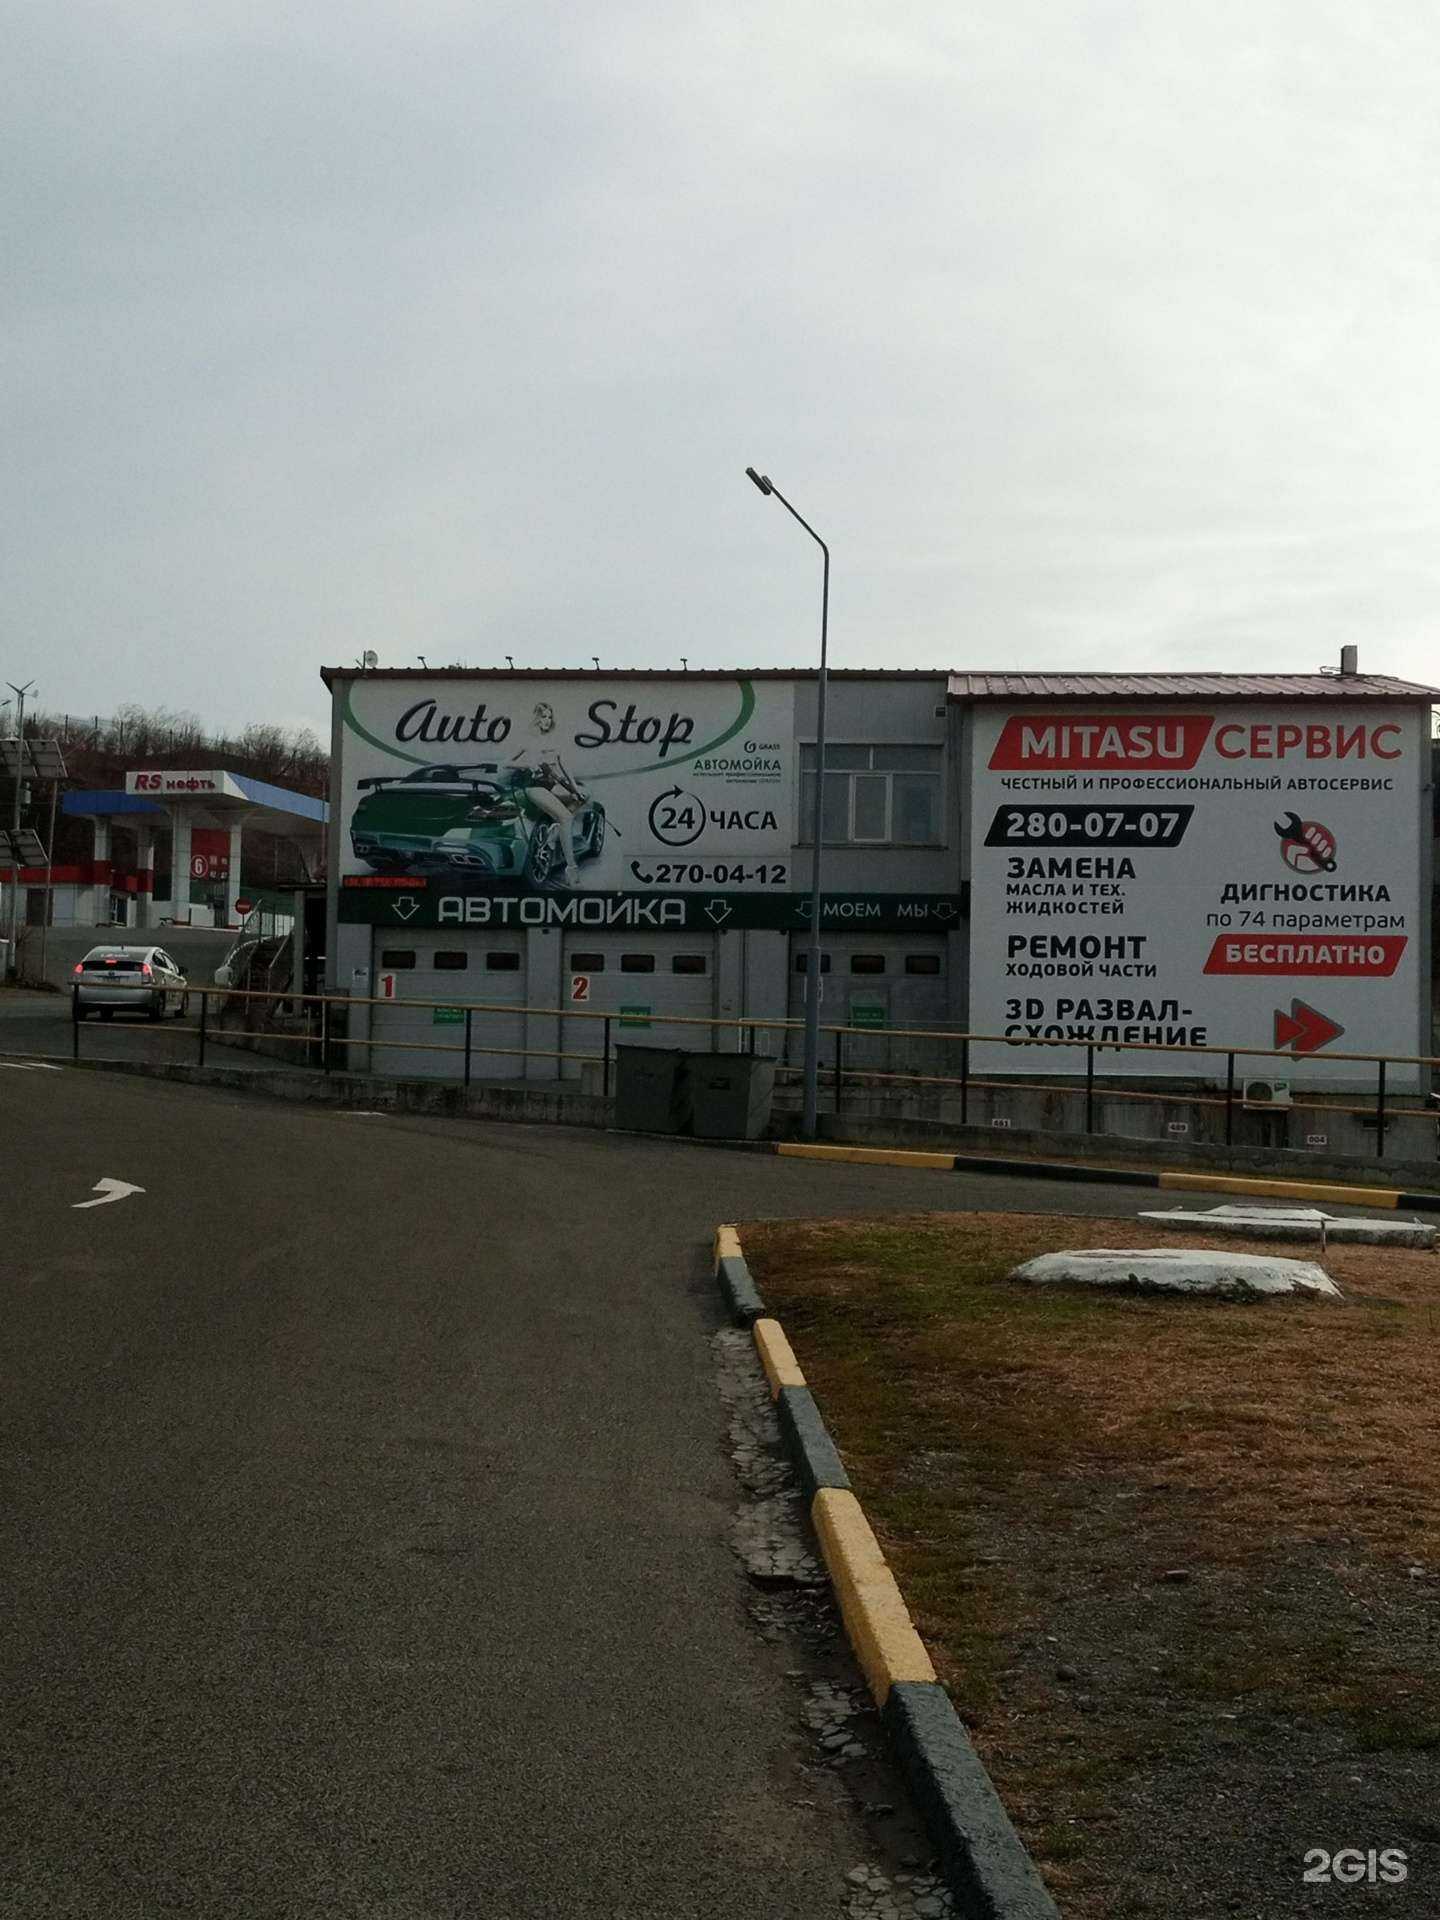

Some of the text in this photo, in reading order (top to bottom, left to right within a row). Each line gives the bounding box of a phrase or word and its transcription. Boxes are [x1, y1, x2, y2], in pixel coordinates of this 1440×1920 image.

[395, 698, 695, 757] Auto Stop
[1021, 724, 1403, 760] MITASU СЕРВИС
[694, 757, 781, 771] АВТОМОЙКА
[134, 774, 216, 791] RS нефть
[1001, 775, 1393, 791] ЧЕСТНЫЙ И ПРОФЕССИОНАЛЬНЫЙ АВТОСЕРВИС
[660, 807, 778, 830] 24 ЧАСА
[1006, 811, 1180, 839] 280-07-07
[194, 857, 204, 875] 6
[656, 864, 787, 884] 270-04-12
[1007, 857, 1136, 879] ЗАМЕНА
[1006, 883, 1126, 897] МАСЛА И ТЕХ.
[1221, 883, 1391, 904] ДИГНОСТИКА
[823, 902, 928, 917] МОЕМ МЫ
[1005, 898, 1124, 916] ЖИДКОСТЕЙ
[1206, 911, 1405, 932] по 74 параметрам
[1007, 935, 1147, 959] РЕМОНТ
[1226, 943, 1386, 967] БЕСПЛАТНО
[1005, 960, 1157, 978] ХОДОВОЙ ЧАСТИ
[381, 975, 393, 997] 1
[572, 977, 590, 1000] 2
[1005, 998, 1193, 1022] 3D РАЗВАЛ-
